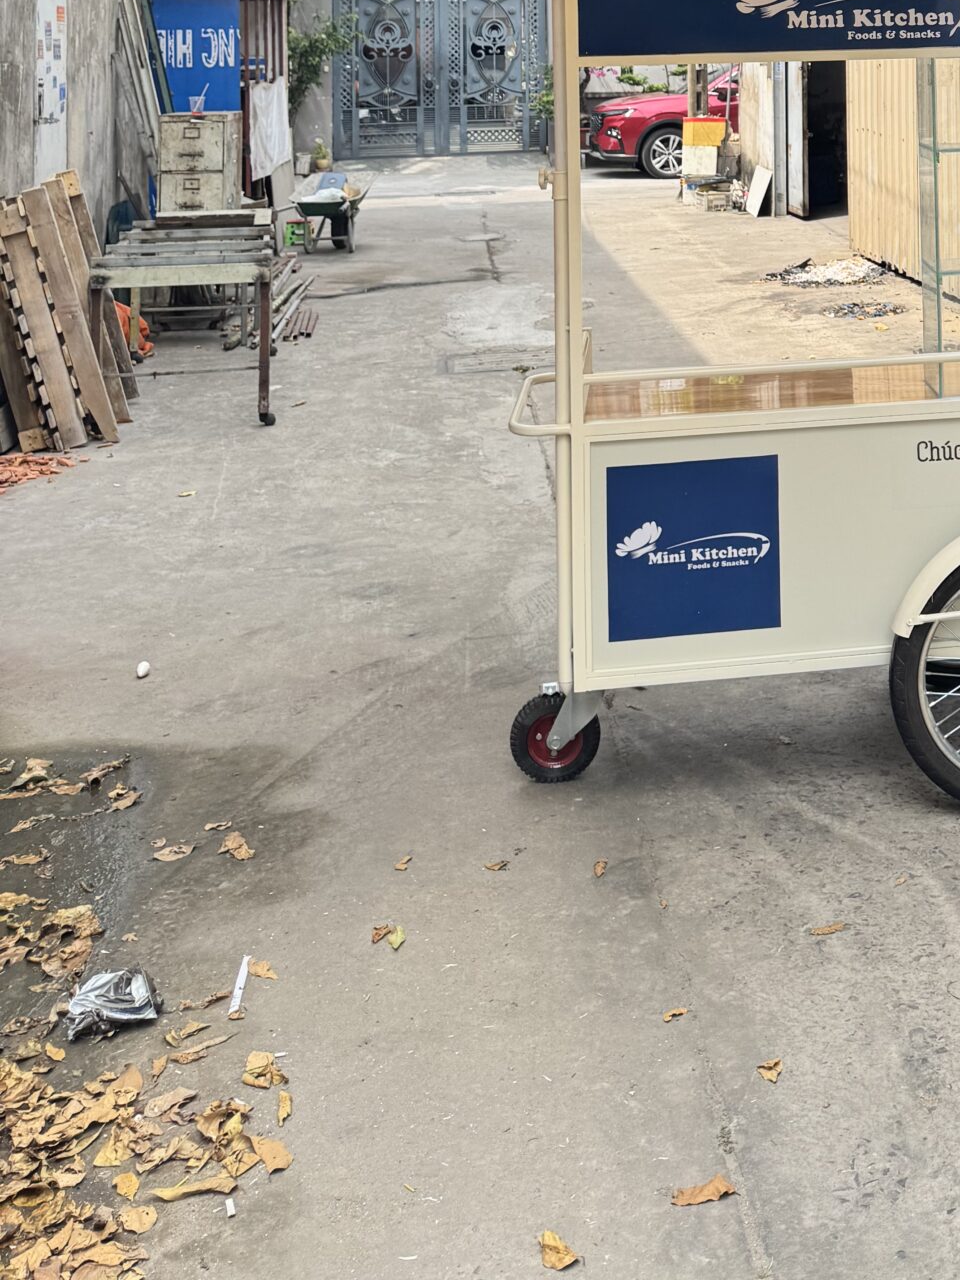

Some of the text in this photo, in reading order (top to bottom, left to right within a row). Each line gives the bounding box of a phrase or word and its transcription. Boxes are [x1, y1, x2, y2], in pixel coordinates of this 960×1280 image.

[787, 8, 954, 29] Mini Kitchen
[847, 29, 941, 40] Foods & Snacks
[648, 546, 758, 565] Mini Kitchen
